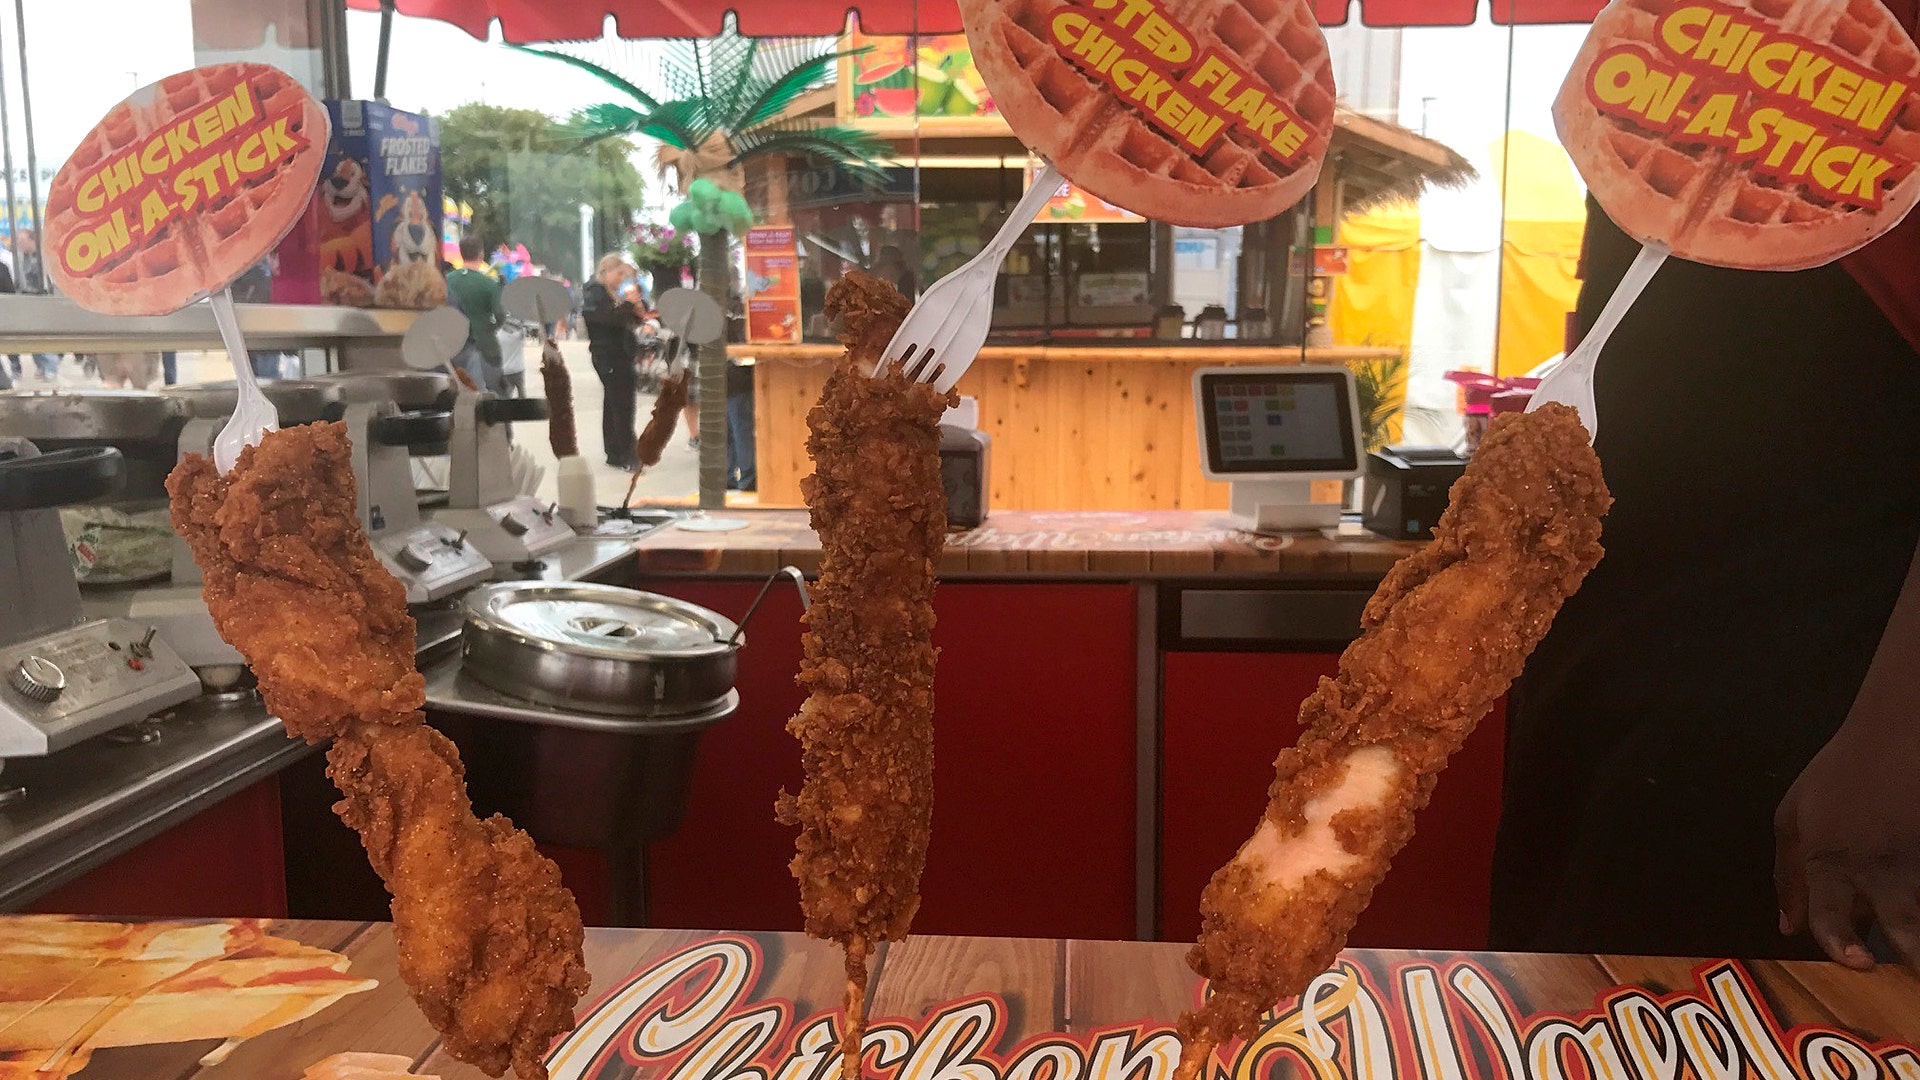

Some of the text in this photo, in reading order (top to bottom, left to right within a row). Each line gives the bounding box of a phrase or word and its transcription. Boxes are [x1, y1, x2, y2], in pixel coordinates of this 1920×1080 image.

[1052, 12, 1225, 149] CHICKEN
[1189, 55, 1308, 158] FLAKE
[1594, 53, 1894, 200] ON-A-STICK
[1662, 7, 1907, 131] CHICKEN
[66, 117, 297, 272] ON-A-STICK
[77, 81, 255, 212] CHICKEN
[380, 137, 430, 157] FROSTED
[385, 156, 428, 176] FLAKES
